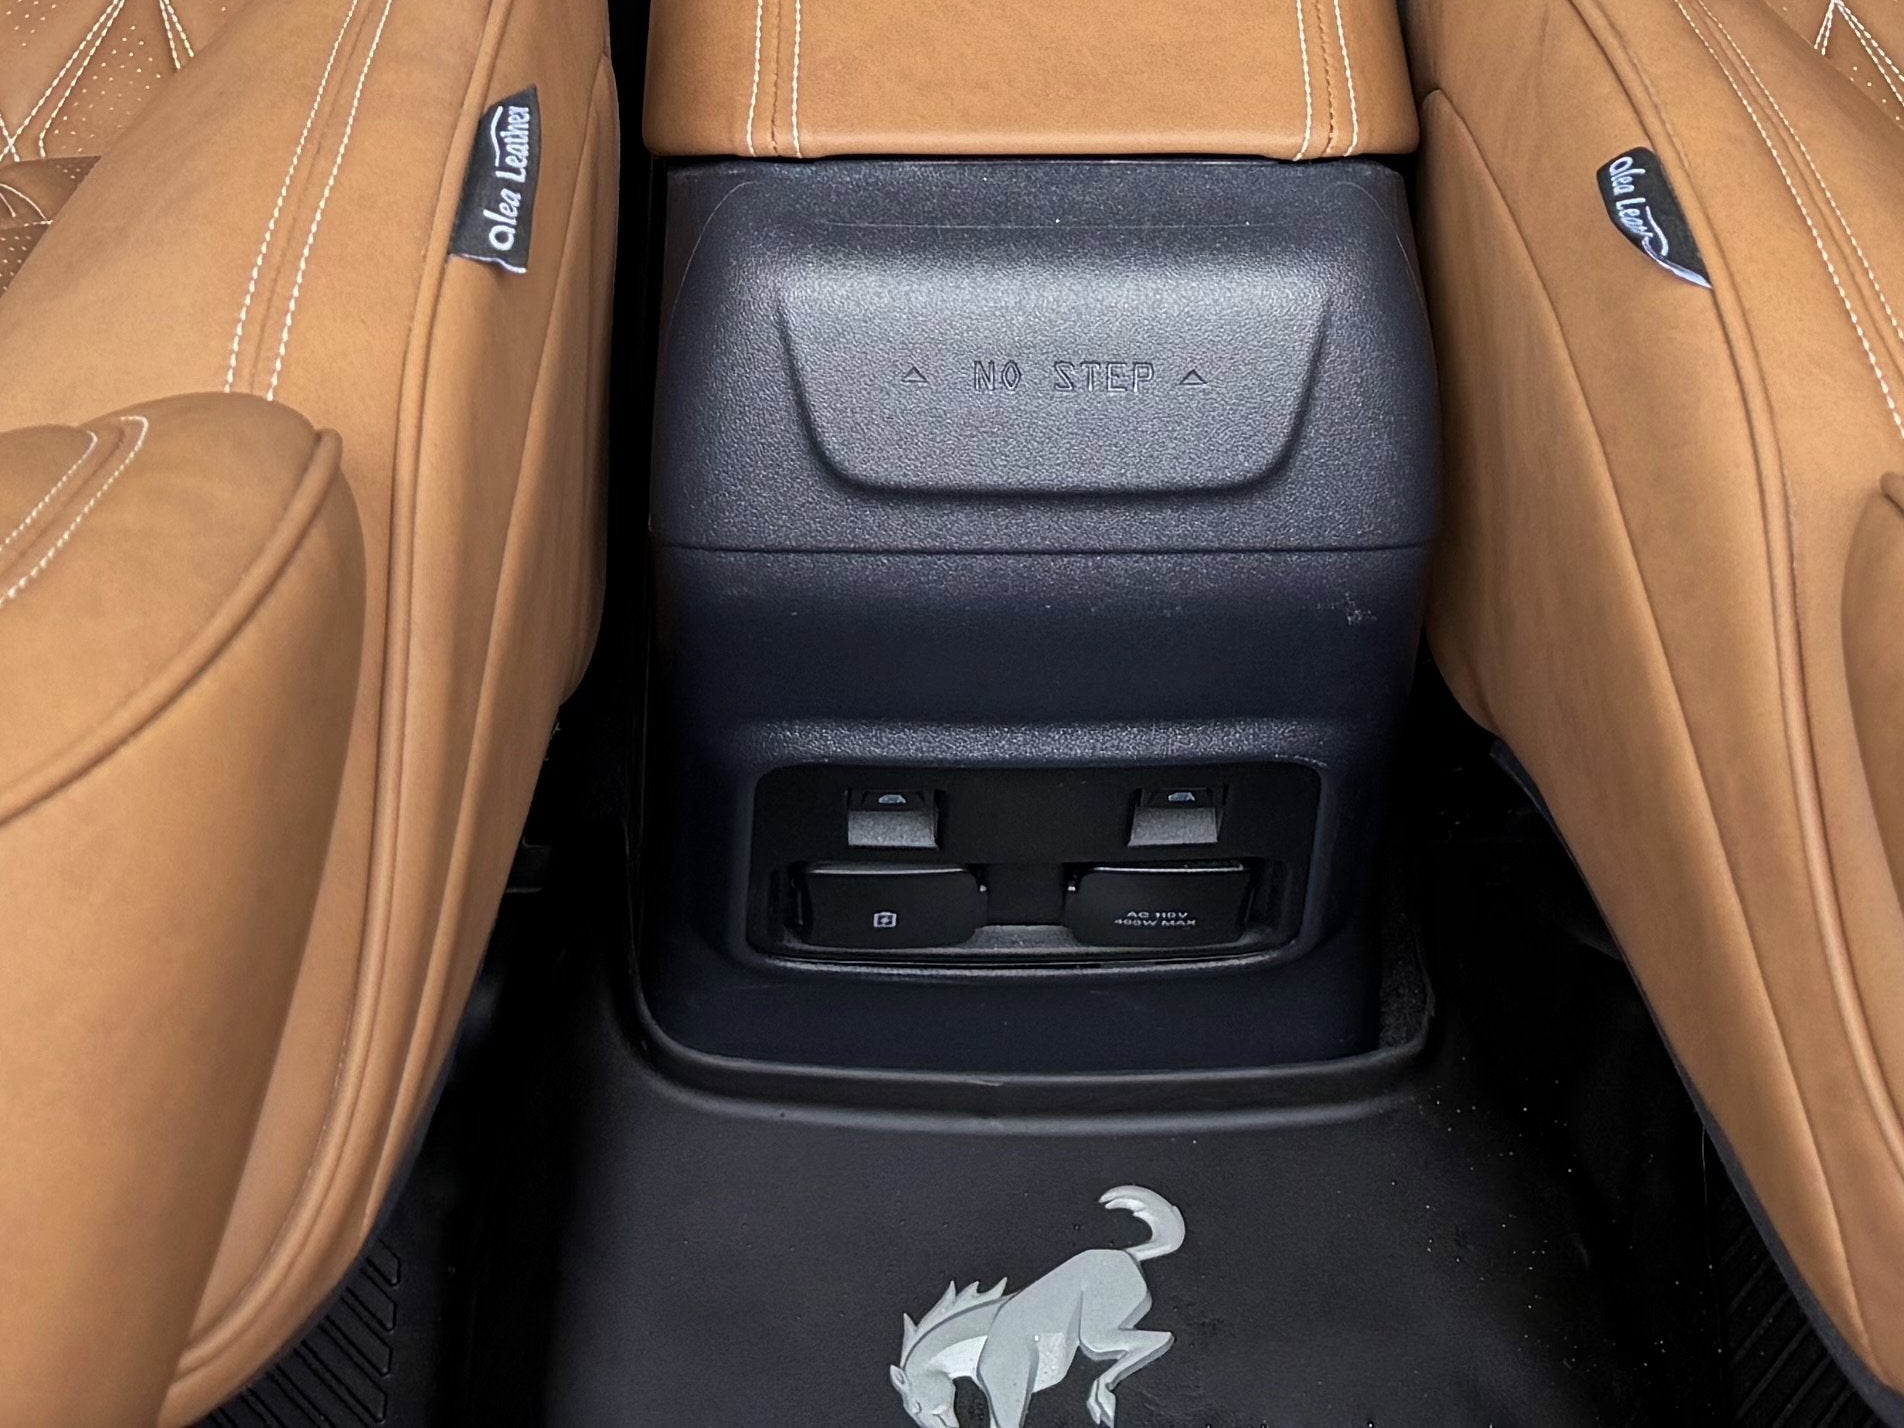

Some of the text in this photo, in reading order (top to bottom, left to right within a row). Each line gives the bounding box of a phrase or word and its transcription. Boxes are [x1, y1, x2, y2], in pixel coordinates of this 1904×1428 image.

[495, 105, 531, 185] Leather
[972, 359, 1155, 394] NO STEP
